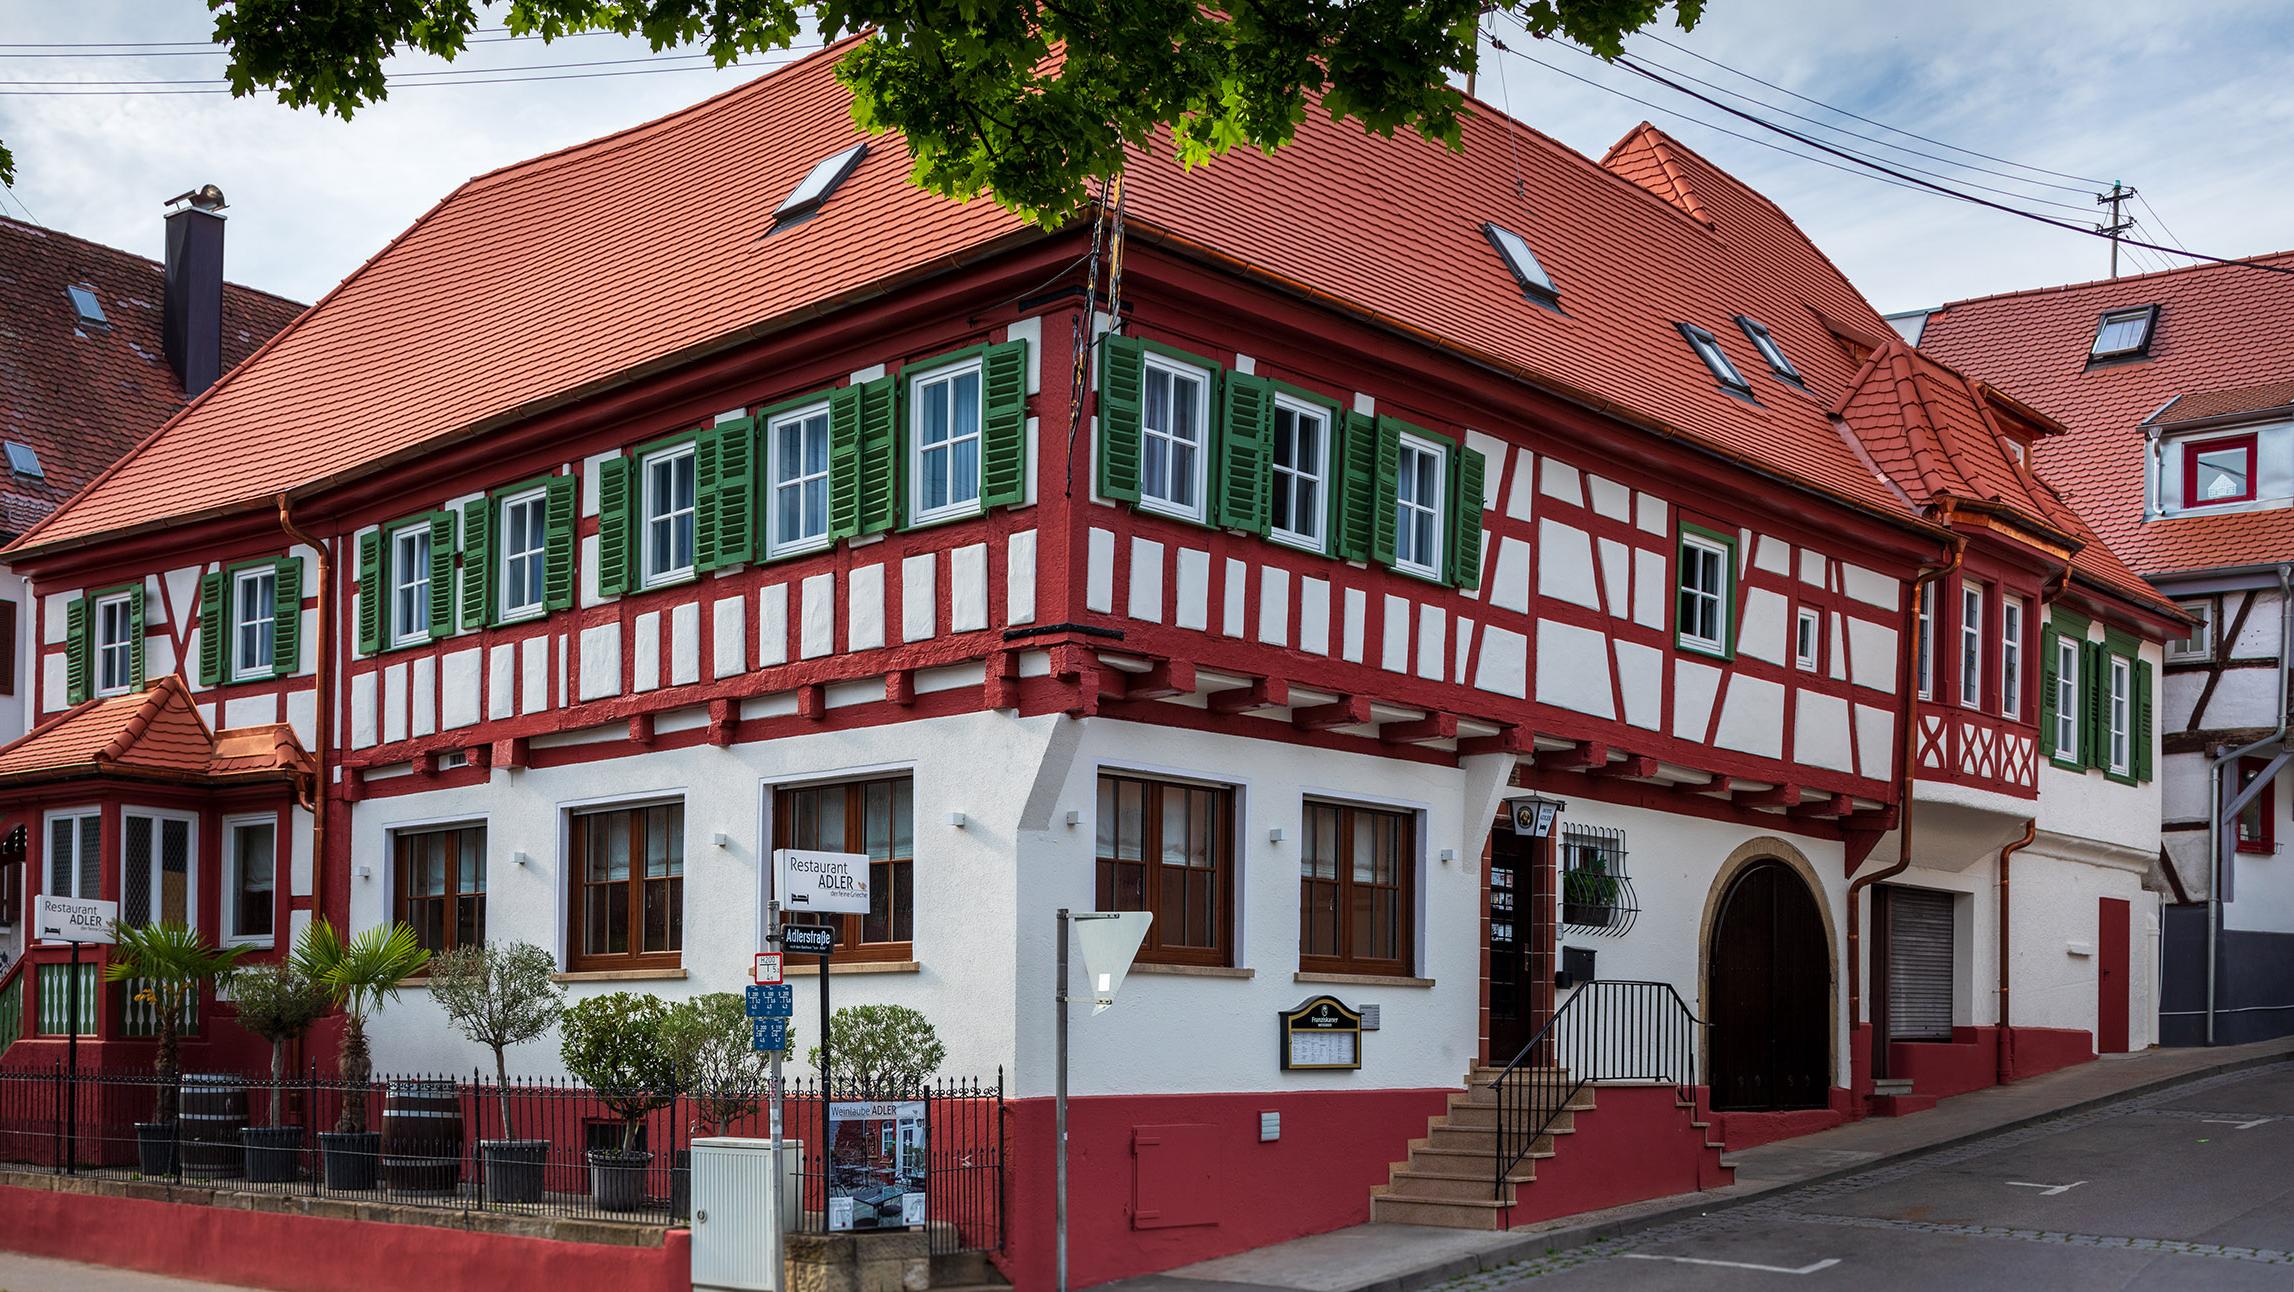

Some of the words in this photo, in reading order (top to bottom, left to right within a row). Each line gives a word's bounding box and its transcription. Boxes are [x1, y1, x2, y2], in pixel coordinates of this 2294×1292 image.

[790, 856, 848, 875] Restaurant
[818, 874, 854, 890] ADLER
[45, 900, 98, 915] Restaurant
[70, 914, 102, 926] ADLER
[786, 928, 831, 946] Adlerstraße
[831, 1106, 871, 1117] Weinlaube
[871, 1104, 897, 1116] ADLER
